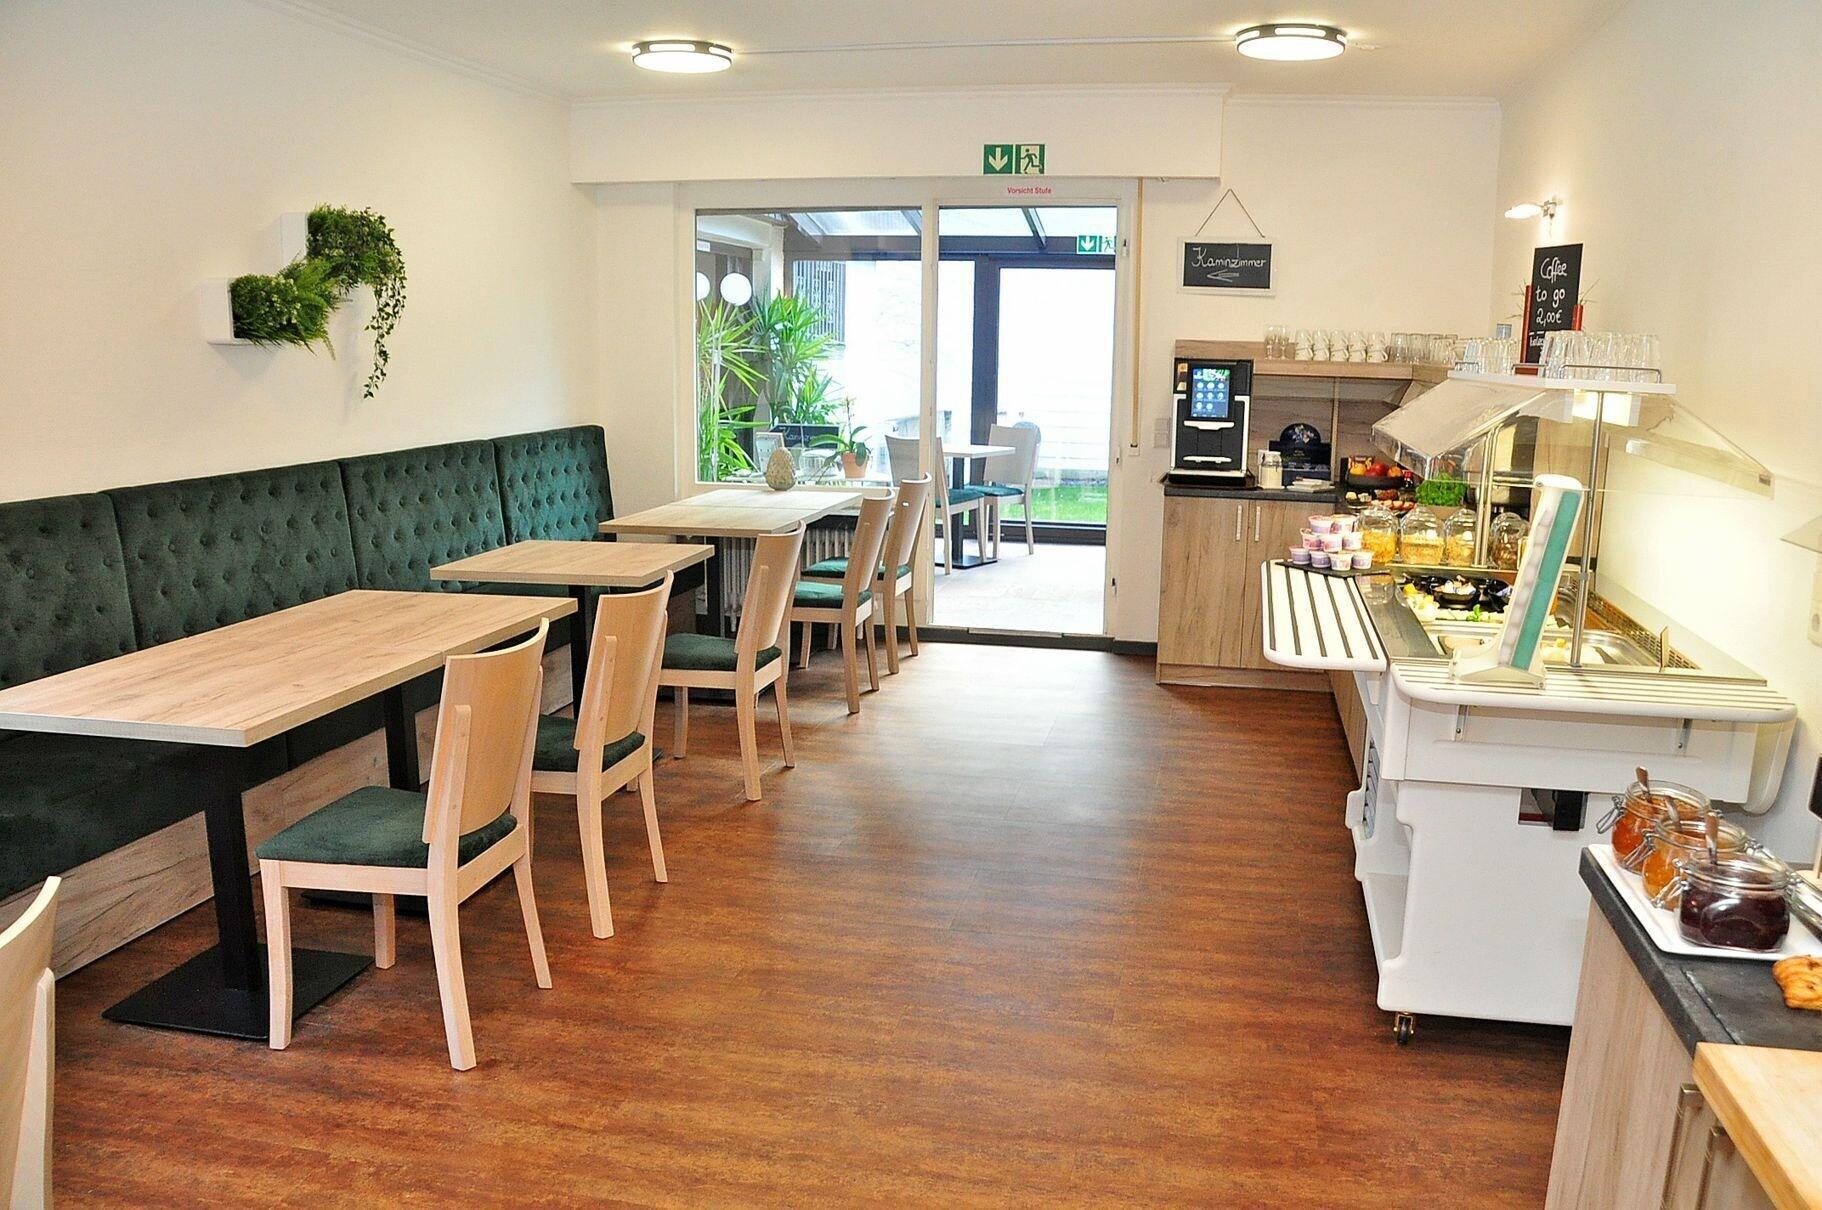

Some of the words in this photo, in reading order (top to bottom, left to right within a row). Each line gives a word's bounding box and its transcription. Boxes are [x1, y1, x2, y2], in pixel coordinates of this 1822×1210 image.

[1007, 186, 1034, 194] Vorsicht
[1035, 186, 1052, 194] Stufe
[1191, 246, 1266, 268] Kaminzimmer
[1540, 256, 1568, 283] Coffee
[1536, 285, 1548, 302] to
[1552, 288, 1566, 308] go
[1535, 308, 1563, 327] 2,00€
